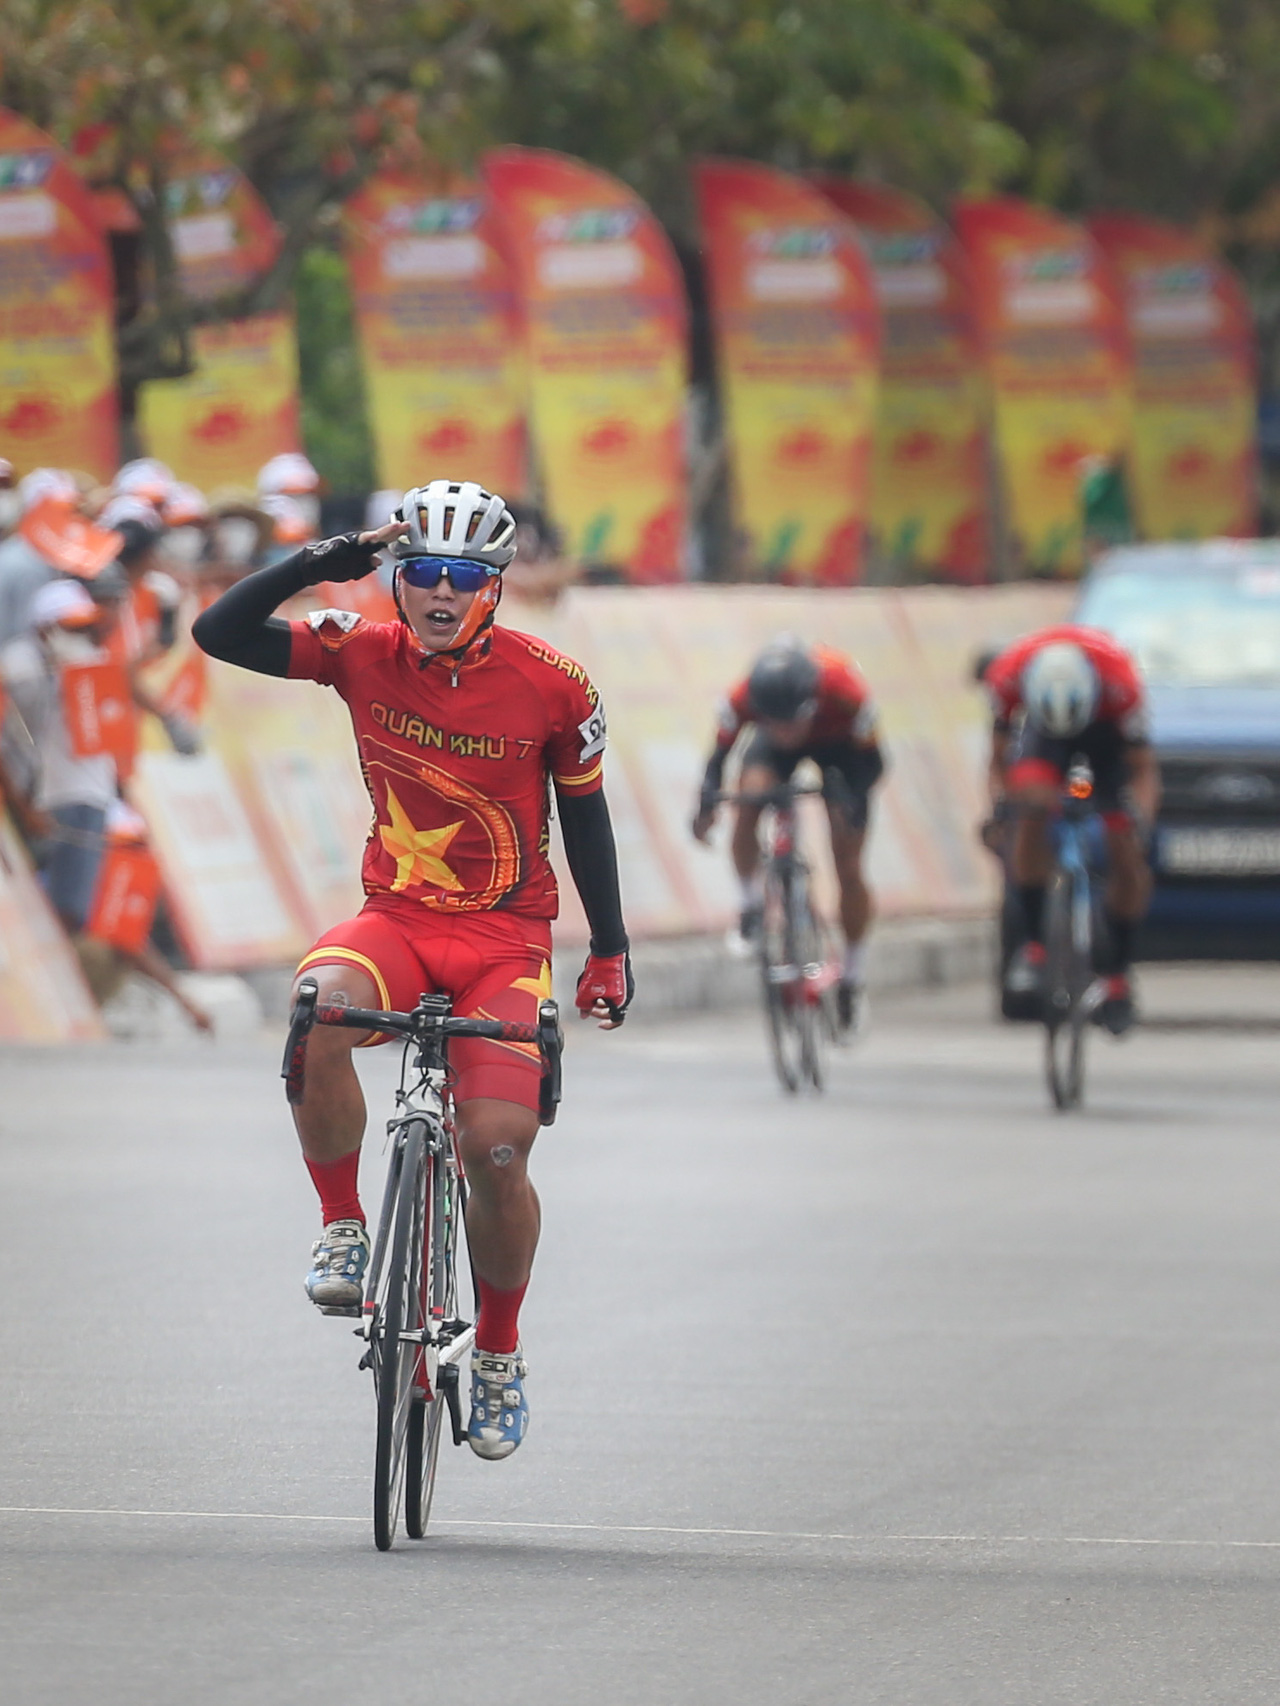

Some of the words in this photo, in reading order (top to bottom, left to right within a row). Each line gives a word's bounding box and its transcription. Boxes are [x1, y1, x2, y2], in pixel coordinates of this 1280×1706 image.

[370, 701, 444, 750] QUÂN
[450, 733, 506, 760] KHU
[516, 739, 535, 759] 7
[330, 1228, 358, 1239] SIDI
[480, 1359, 509, 1373] SIDI
